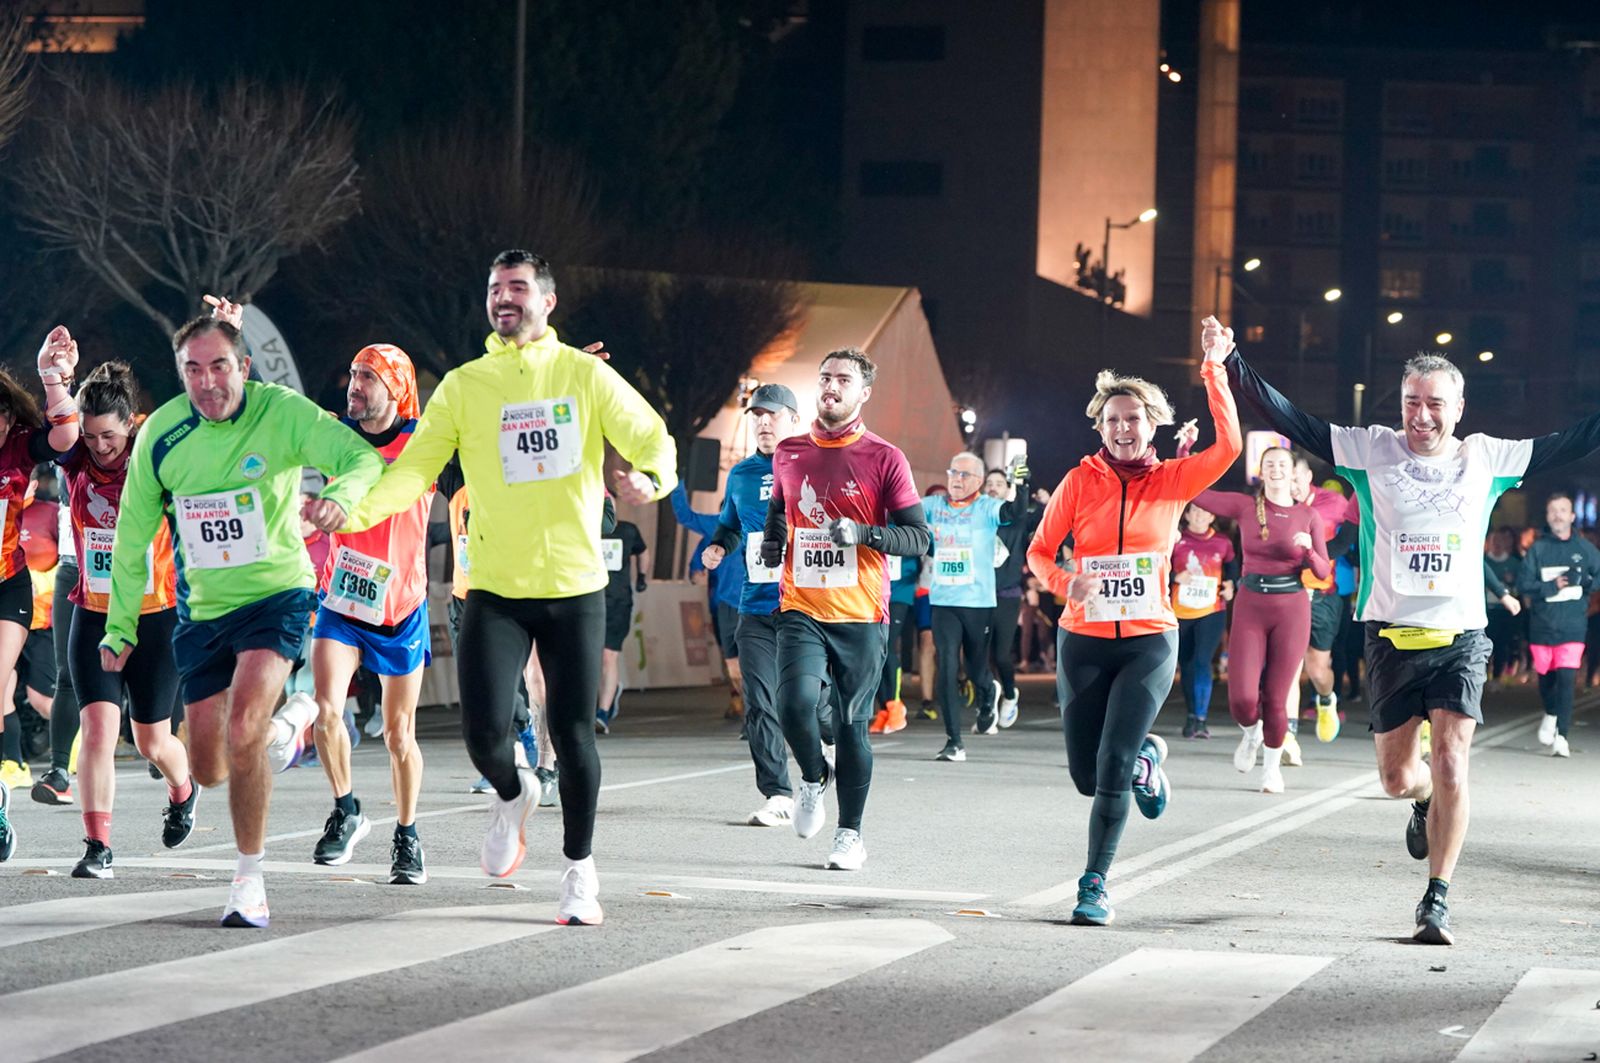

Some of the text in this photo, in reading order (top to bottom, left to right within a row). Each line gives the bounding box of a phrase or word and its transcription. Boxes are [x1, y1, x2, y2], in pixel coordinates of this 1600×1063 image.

[510, 410, 545, 421] NOCHE DE
[501, 423, 517, 432] SAN
[517, 428, 559, 454] 498
[194, 501, 216, 509] NOCHE
[100, 511, 117, 528] 43
[186, 512, 202, 520] SAN
[810, 507, 824, 524] 43
[200, 518, 244, 543] 639
[1400, 544, 1414, 552] SAN
[94, 551, 112, 572] 93
[804, 550, 845, 567] 6404
[941, 561, 964, 573] 7769
[1099, 562, 1120, 570] NOCHE
[1409, 553, 1452, 572] 4757
[339, 571, 378, 601] 9386
[1099, 577, 1145, 598] 4759
